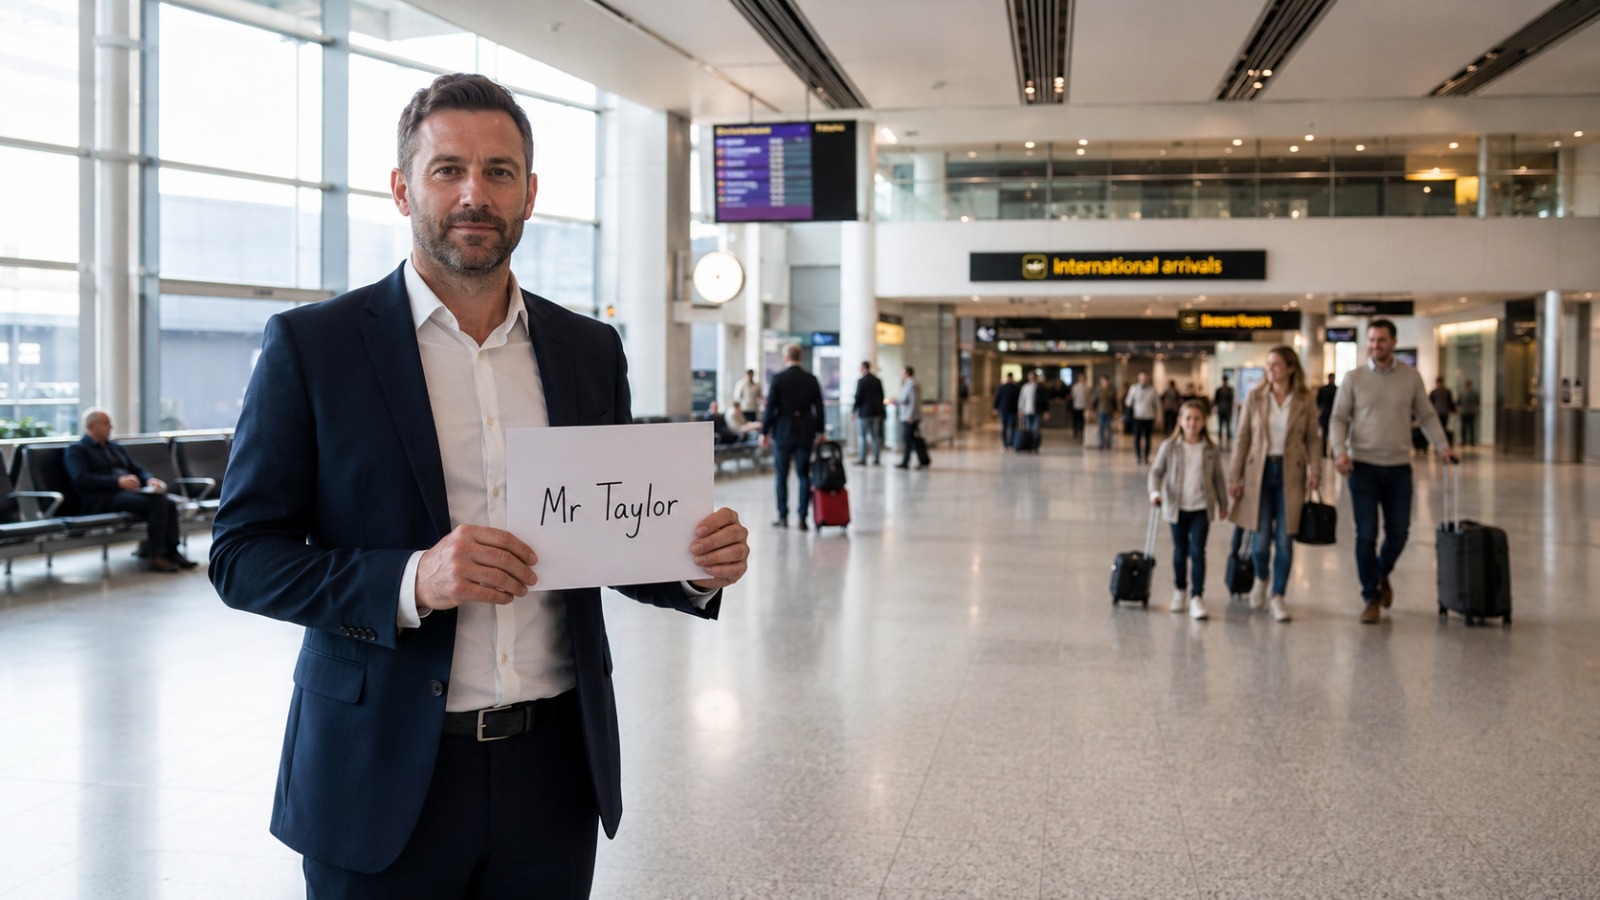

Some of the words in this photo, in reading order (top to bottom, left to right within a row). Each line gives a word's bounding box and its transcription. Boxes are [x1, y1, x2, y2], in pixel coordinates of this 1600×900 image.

[1053, 256, 1159, 275] International
[1161, 256, 1223, 275] arrivals
[540, 486, 582, 526] Mr
[596, 481, 679, 538] Taylor
